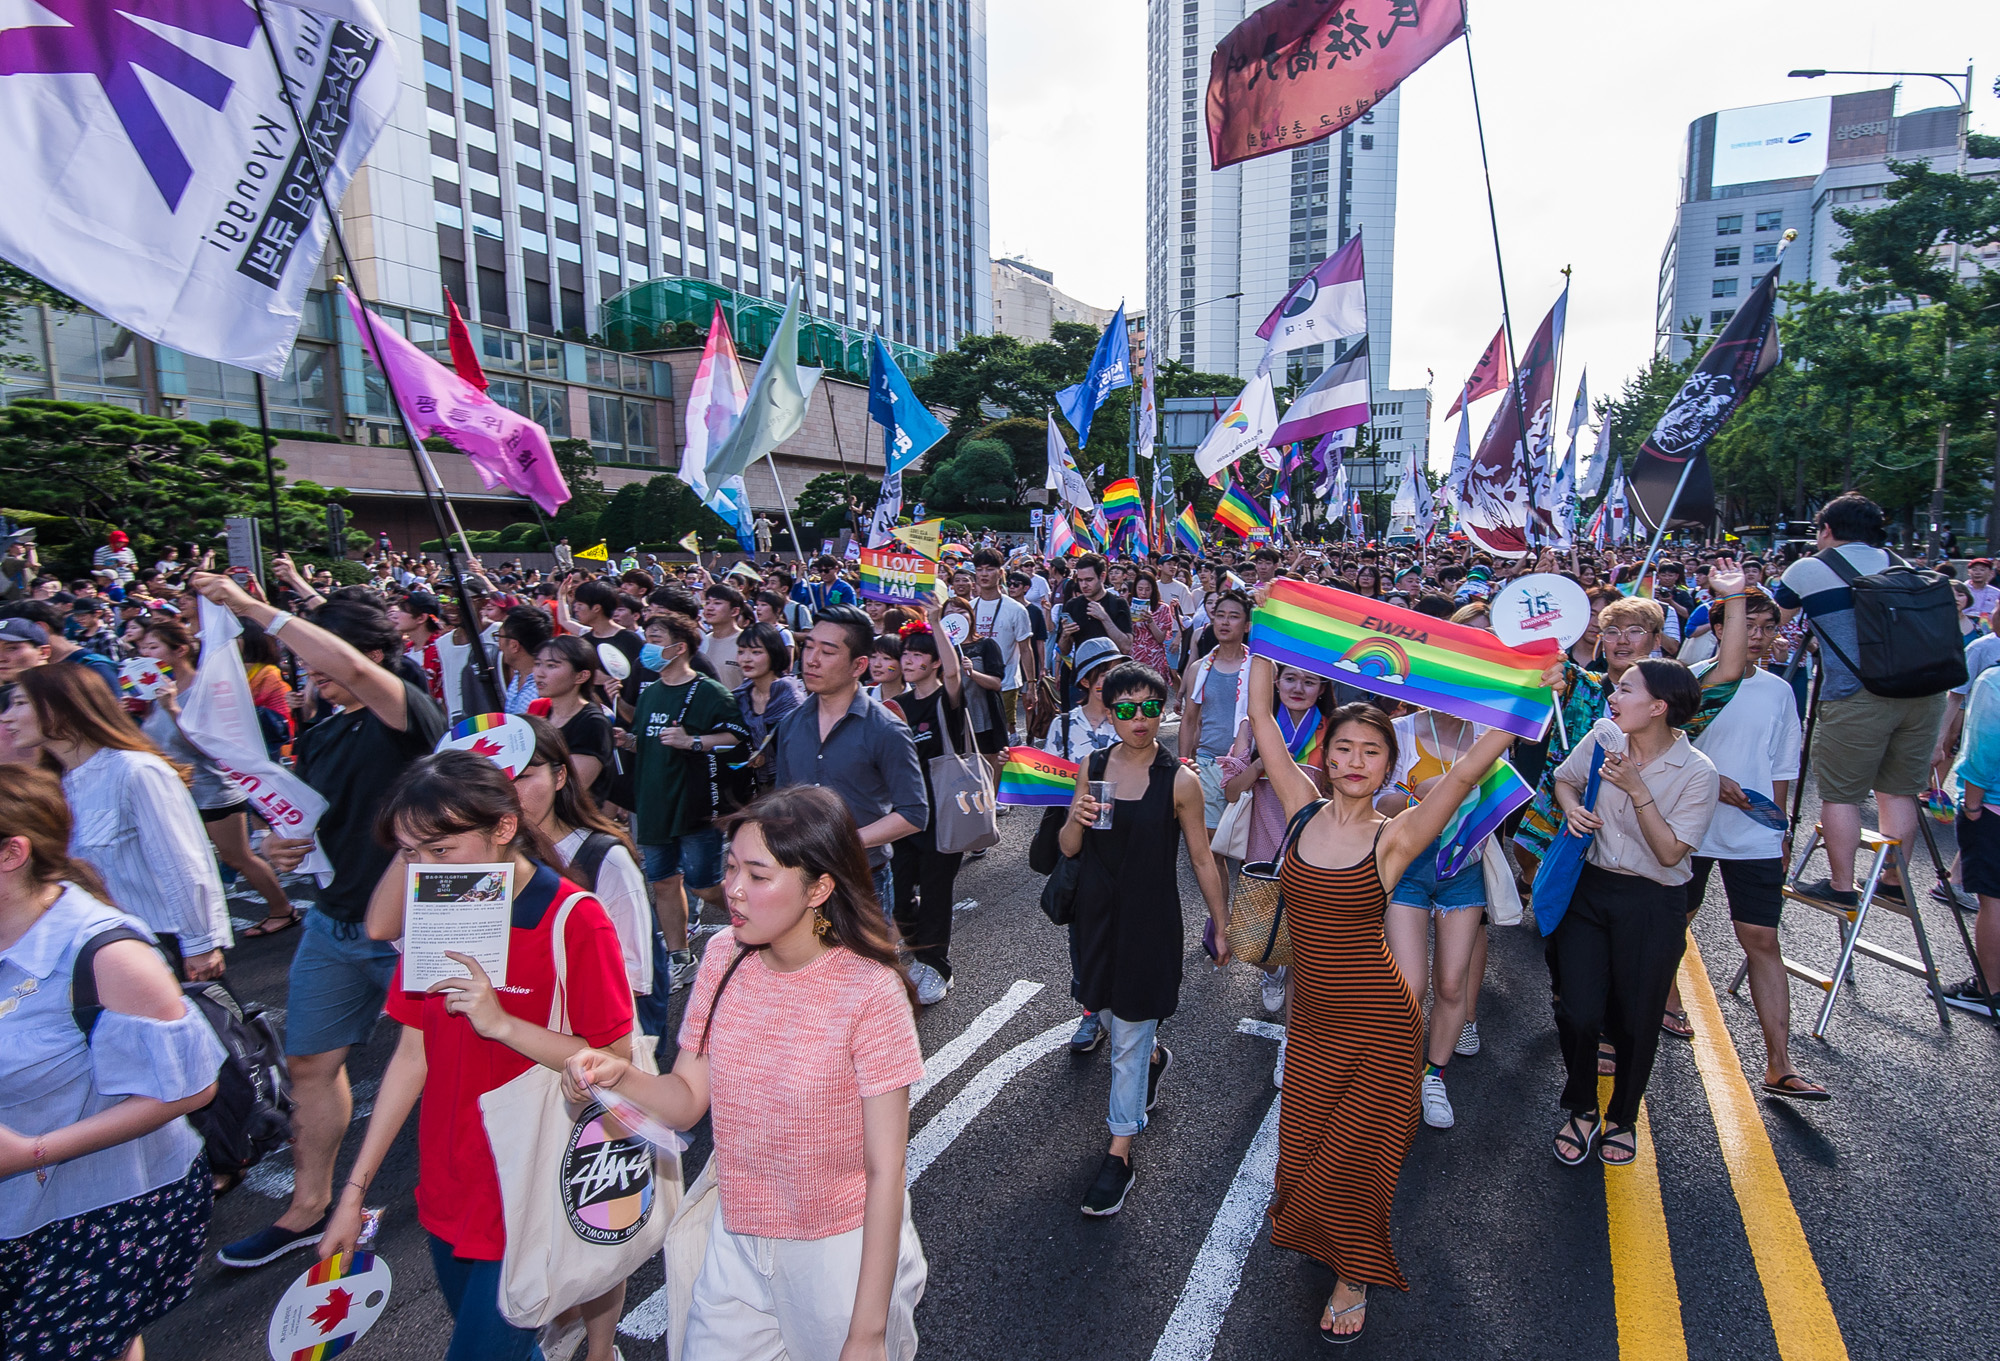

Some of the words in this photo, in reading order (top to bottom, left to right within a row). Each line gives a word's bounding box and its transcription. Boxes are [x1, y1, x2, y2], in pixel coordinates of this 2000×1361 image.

[873, 553, 878, 566] I
[883, 555, 925, 573] LOVE
[879, 568, 917, 586] WHO
[879, 581, 885, 594] I
[888, 584, 915, 599] AM
[1360, 616, 1429, 644] EWHA
[1522, 612, 1559, 628] Anniversary
[708, 754, 718, 778] AVEDA
[1034, 761, 1067, 778] 2018
[710, 782, 719, 806] AVEDA
[258, 791, 304, 826] GET
[570, 1211, 618, 1240] KNOWLEDGE
